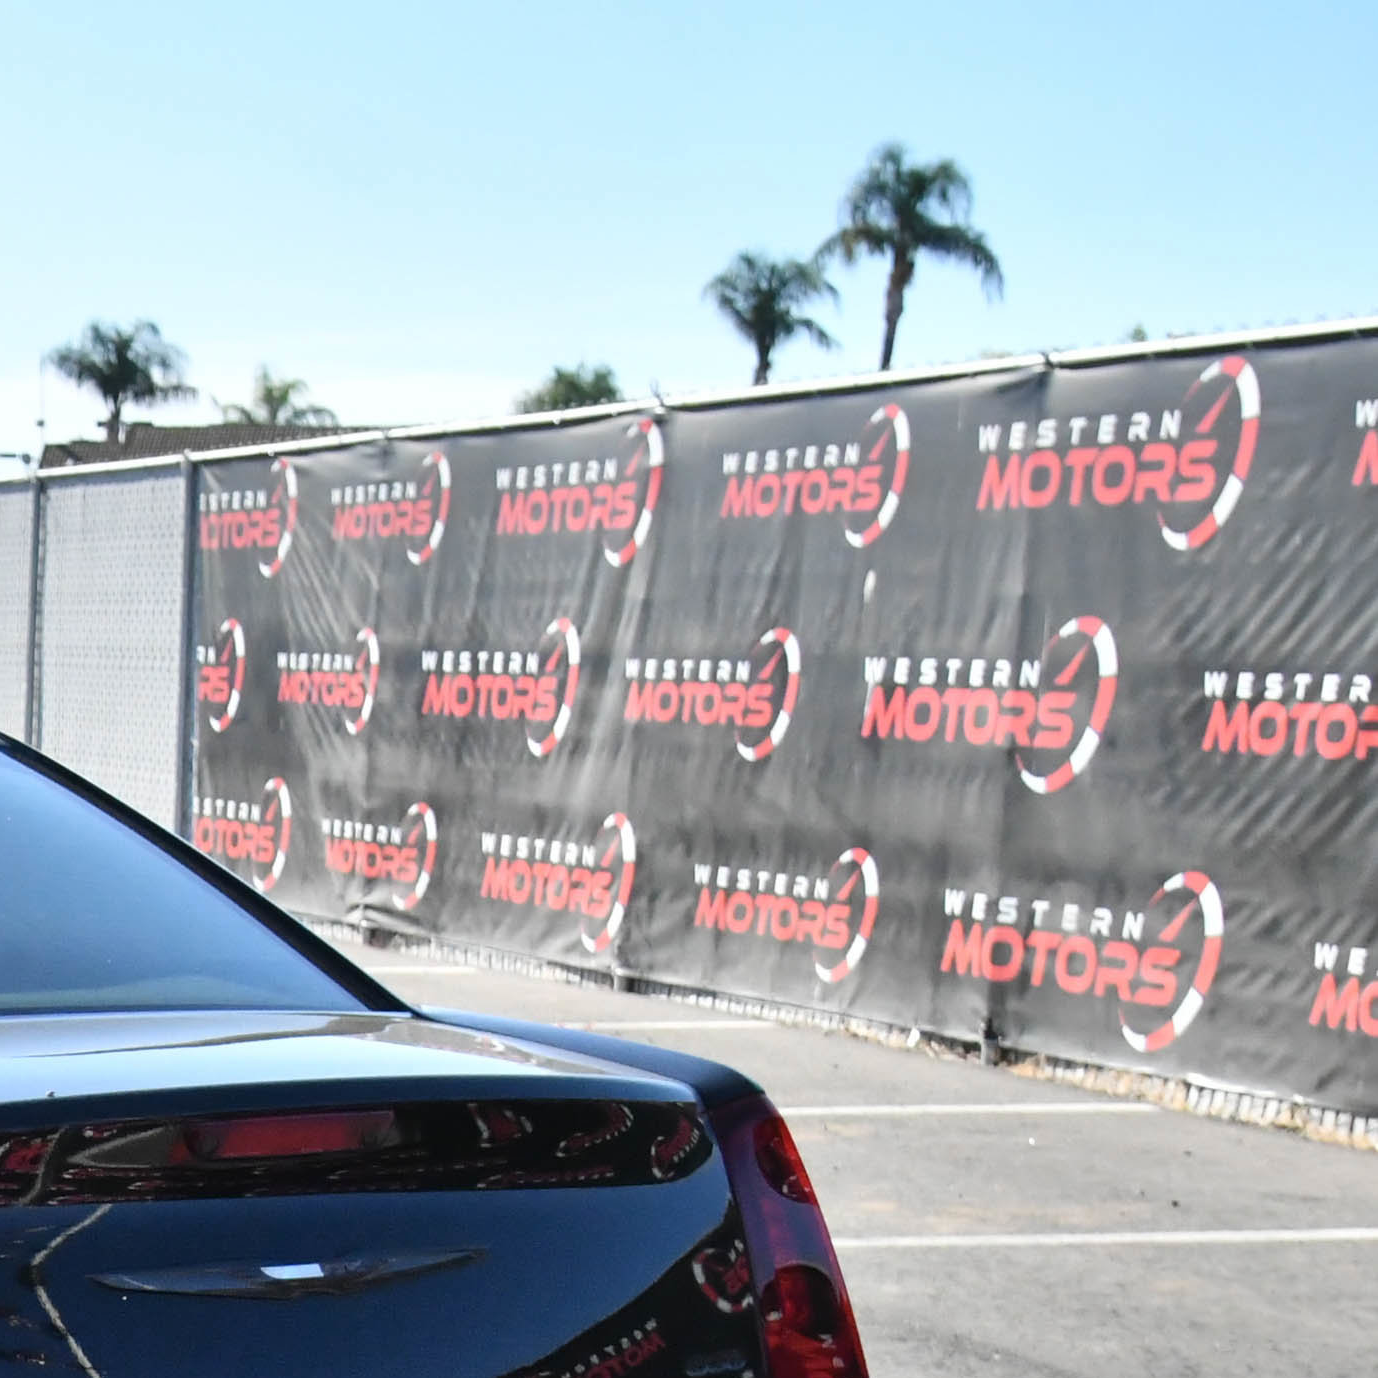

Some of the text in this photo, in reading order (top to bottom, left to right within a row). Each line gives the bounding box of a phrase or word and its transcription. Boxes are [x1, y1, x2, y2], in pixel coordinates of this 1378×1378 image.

[978, 409, 1181, 451] WESTERN
[496, 457, 617, 490] WESTERN
[723, 442, 860, 475] WESTERN
[976, 441, 1217, 510] MOTORS
[496, 481, 637, 535] MOTORS
[720, 464, 883, 519] MOTORS
[332, 500, 432, 540] MOTORS
[421, 650, 539, 674] WESTERN
[625, 658, 751, 682] WESTERN
[864, 656, 1041, 688] WESTERN
[277, 671, 364, 708] MOTORS
[421, 672, 557, 721] MOTORS
[623, 680, 773, 727] MOTORS
[1204, 671, 1372, 702] WESTER
[861, 686, 1076, 748] MOTORS
[322, 818, 402, 844] WESTERN
[481, 832, 595, 867] WESTERN
[325, 837, 418, 882] MOTORS
[480, 856, 613, 918] MOTORS
[694, 863, 829, 899] WESTERN
[695, 887, 850, 949] MOTORS
[944, 888, 1145, 941] WESTERN
[939, 922, 1181, 1005] MOTORS
